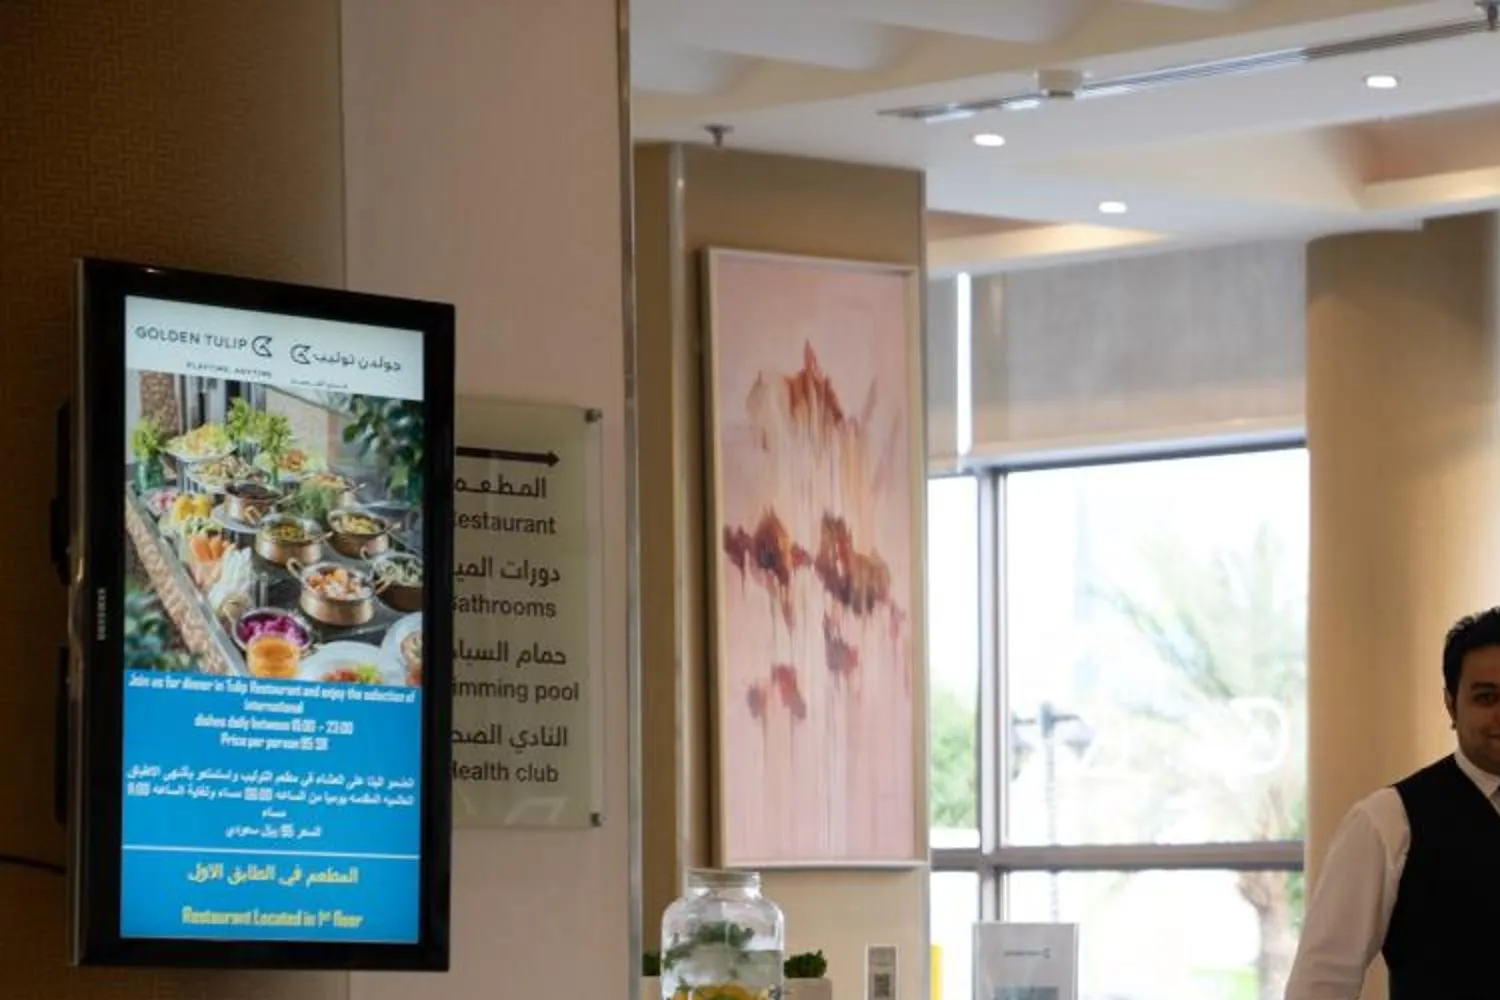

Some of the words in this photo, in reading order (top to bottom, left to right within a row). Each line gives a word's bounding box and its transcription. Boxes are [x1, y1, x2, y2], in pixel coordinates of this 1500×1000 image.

[135, 326, 200, 344] GOLDEN
[204, 334, 248, 350] TULIP
[454, 512, 557, 534] estaurant
[453, 556, 492, 582] المي
[501, 559, 560, 587] دورات
[453, 640, 509, 666] السبا
[516, 642, 566, 668] حمام
[535, 682, 579, 704] pool
[453, 723, 501, 745] الصح
[509, 726, 568, 753] النادي
[515, 763, 559, 782] club
[228, 862, 276, 885] الطابق
[306, 866, 358, 888] المطعم
